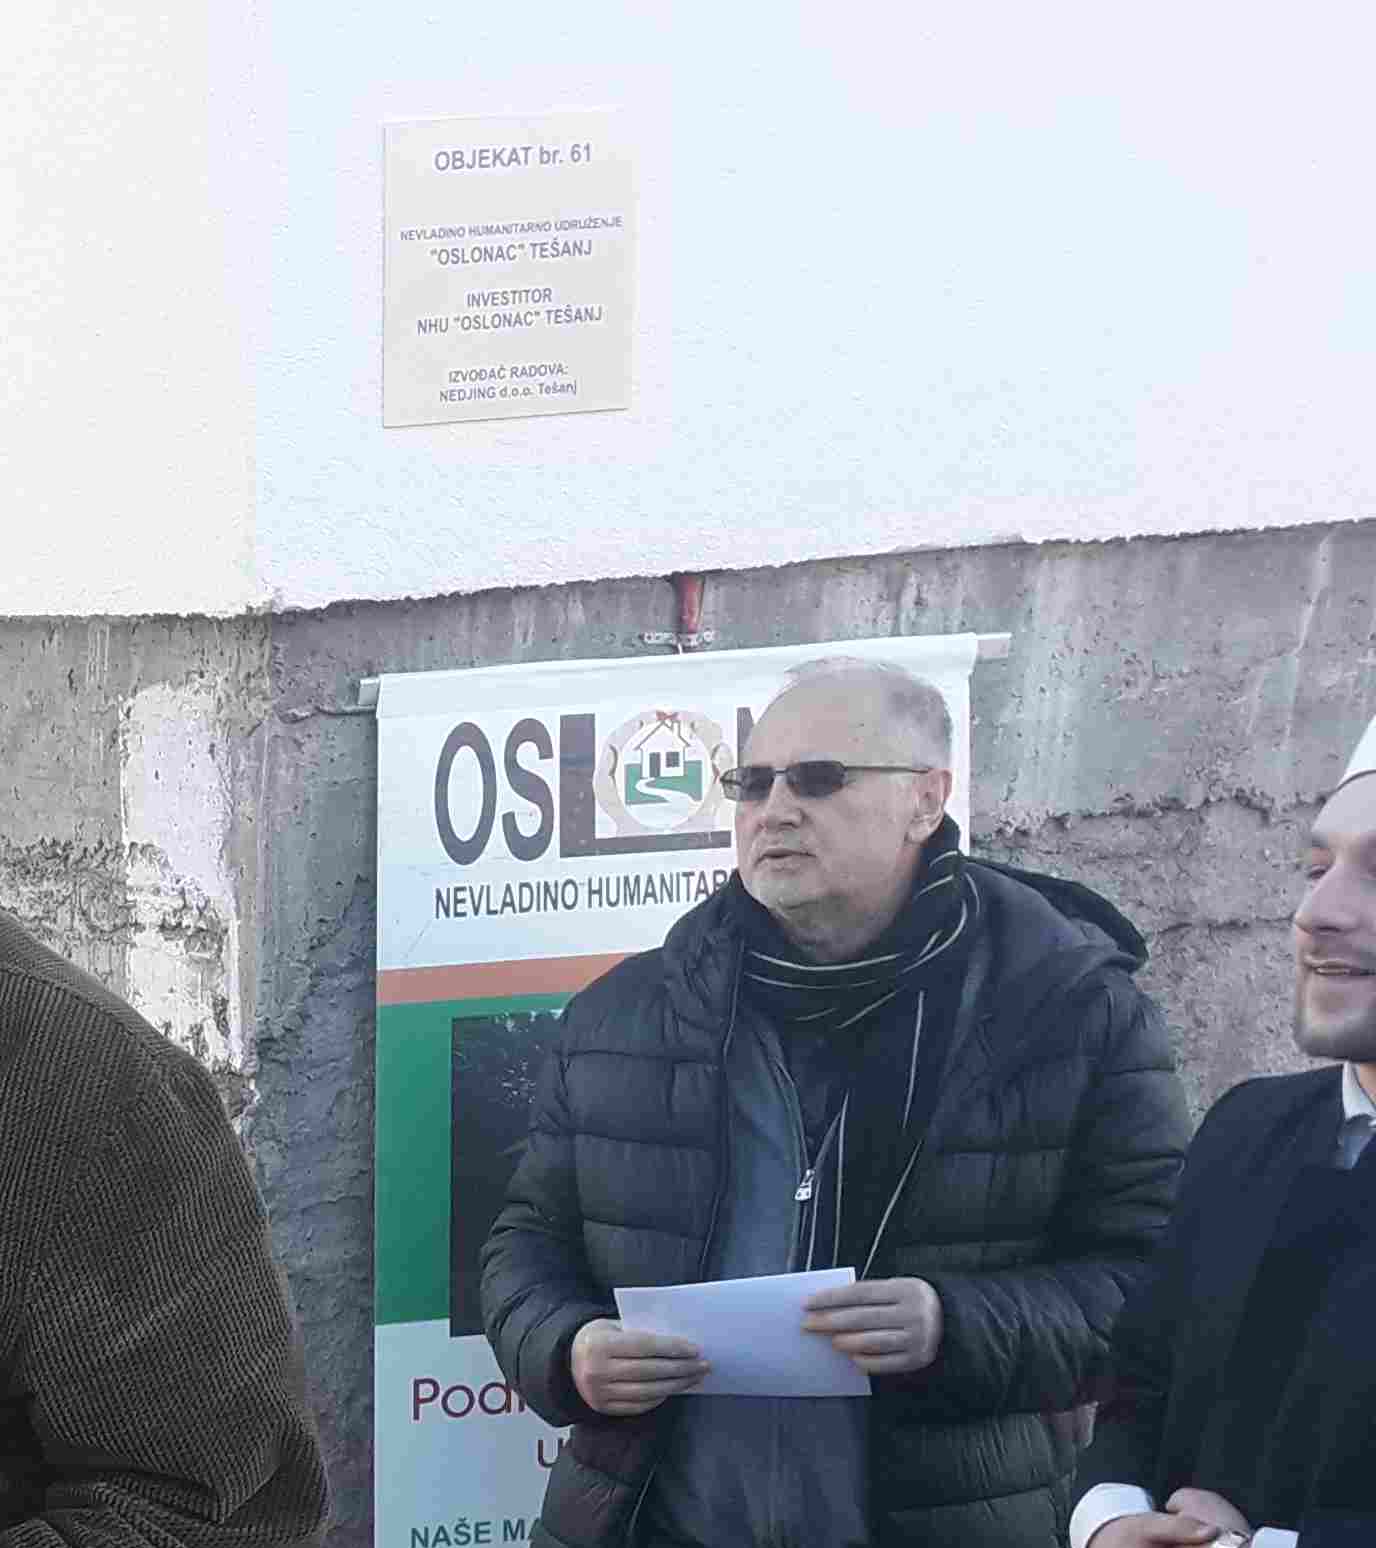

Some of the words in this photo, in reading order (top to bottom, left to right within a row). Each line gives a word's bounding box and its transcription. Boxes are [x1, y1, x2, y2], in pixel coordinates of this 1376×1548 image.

[435, 146, 532, 171] OBJEKAT
[539, 145, 563, 166] br.
[571, 143, 591, 164] 61
[400, 226, 465, 241] NEVLADINO
[468, 221, 551, 237] HUMANITARNO
[530, 238, 592, 259] TEŠANJ
[467, 288, 552, 308] INVESTITOR
[417, 318, 449, 335] NHU
[546, 304, 602, 325] TEŠANJ
[435, 878, 579, 920] NEVLADINO
[588, 868, 737, 909] HUMANITAR
